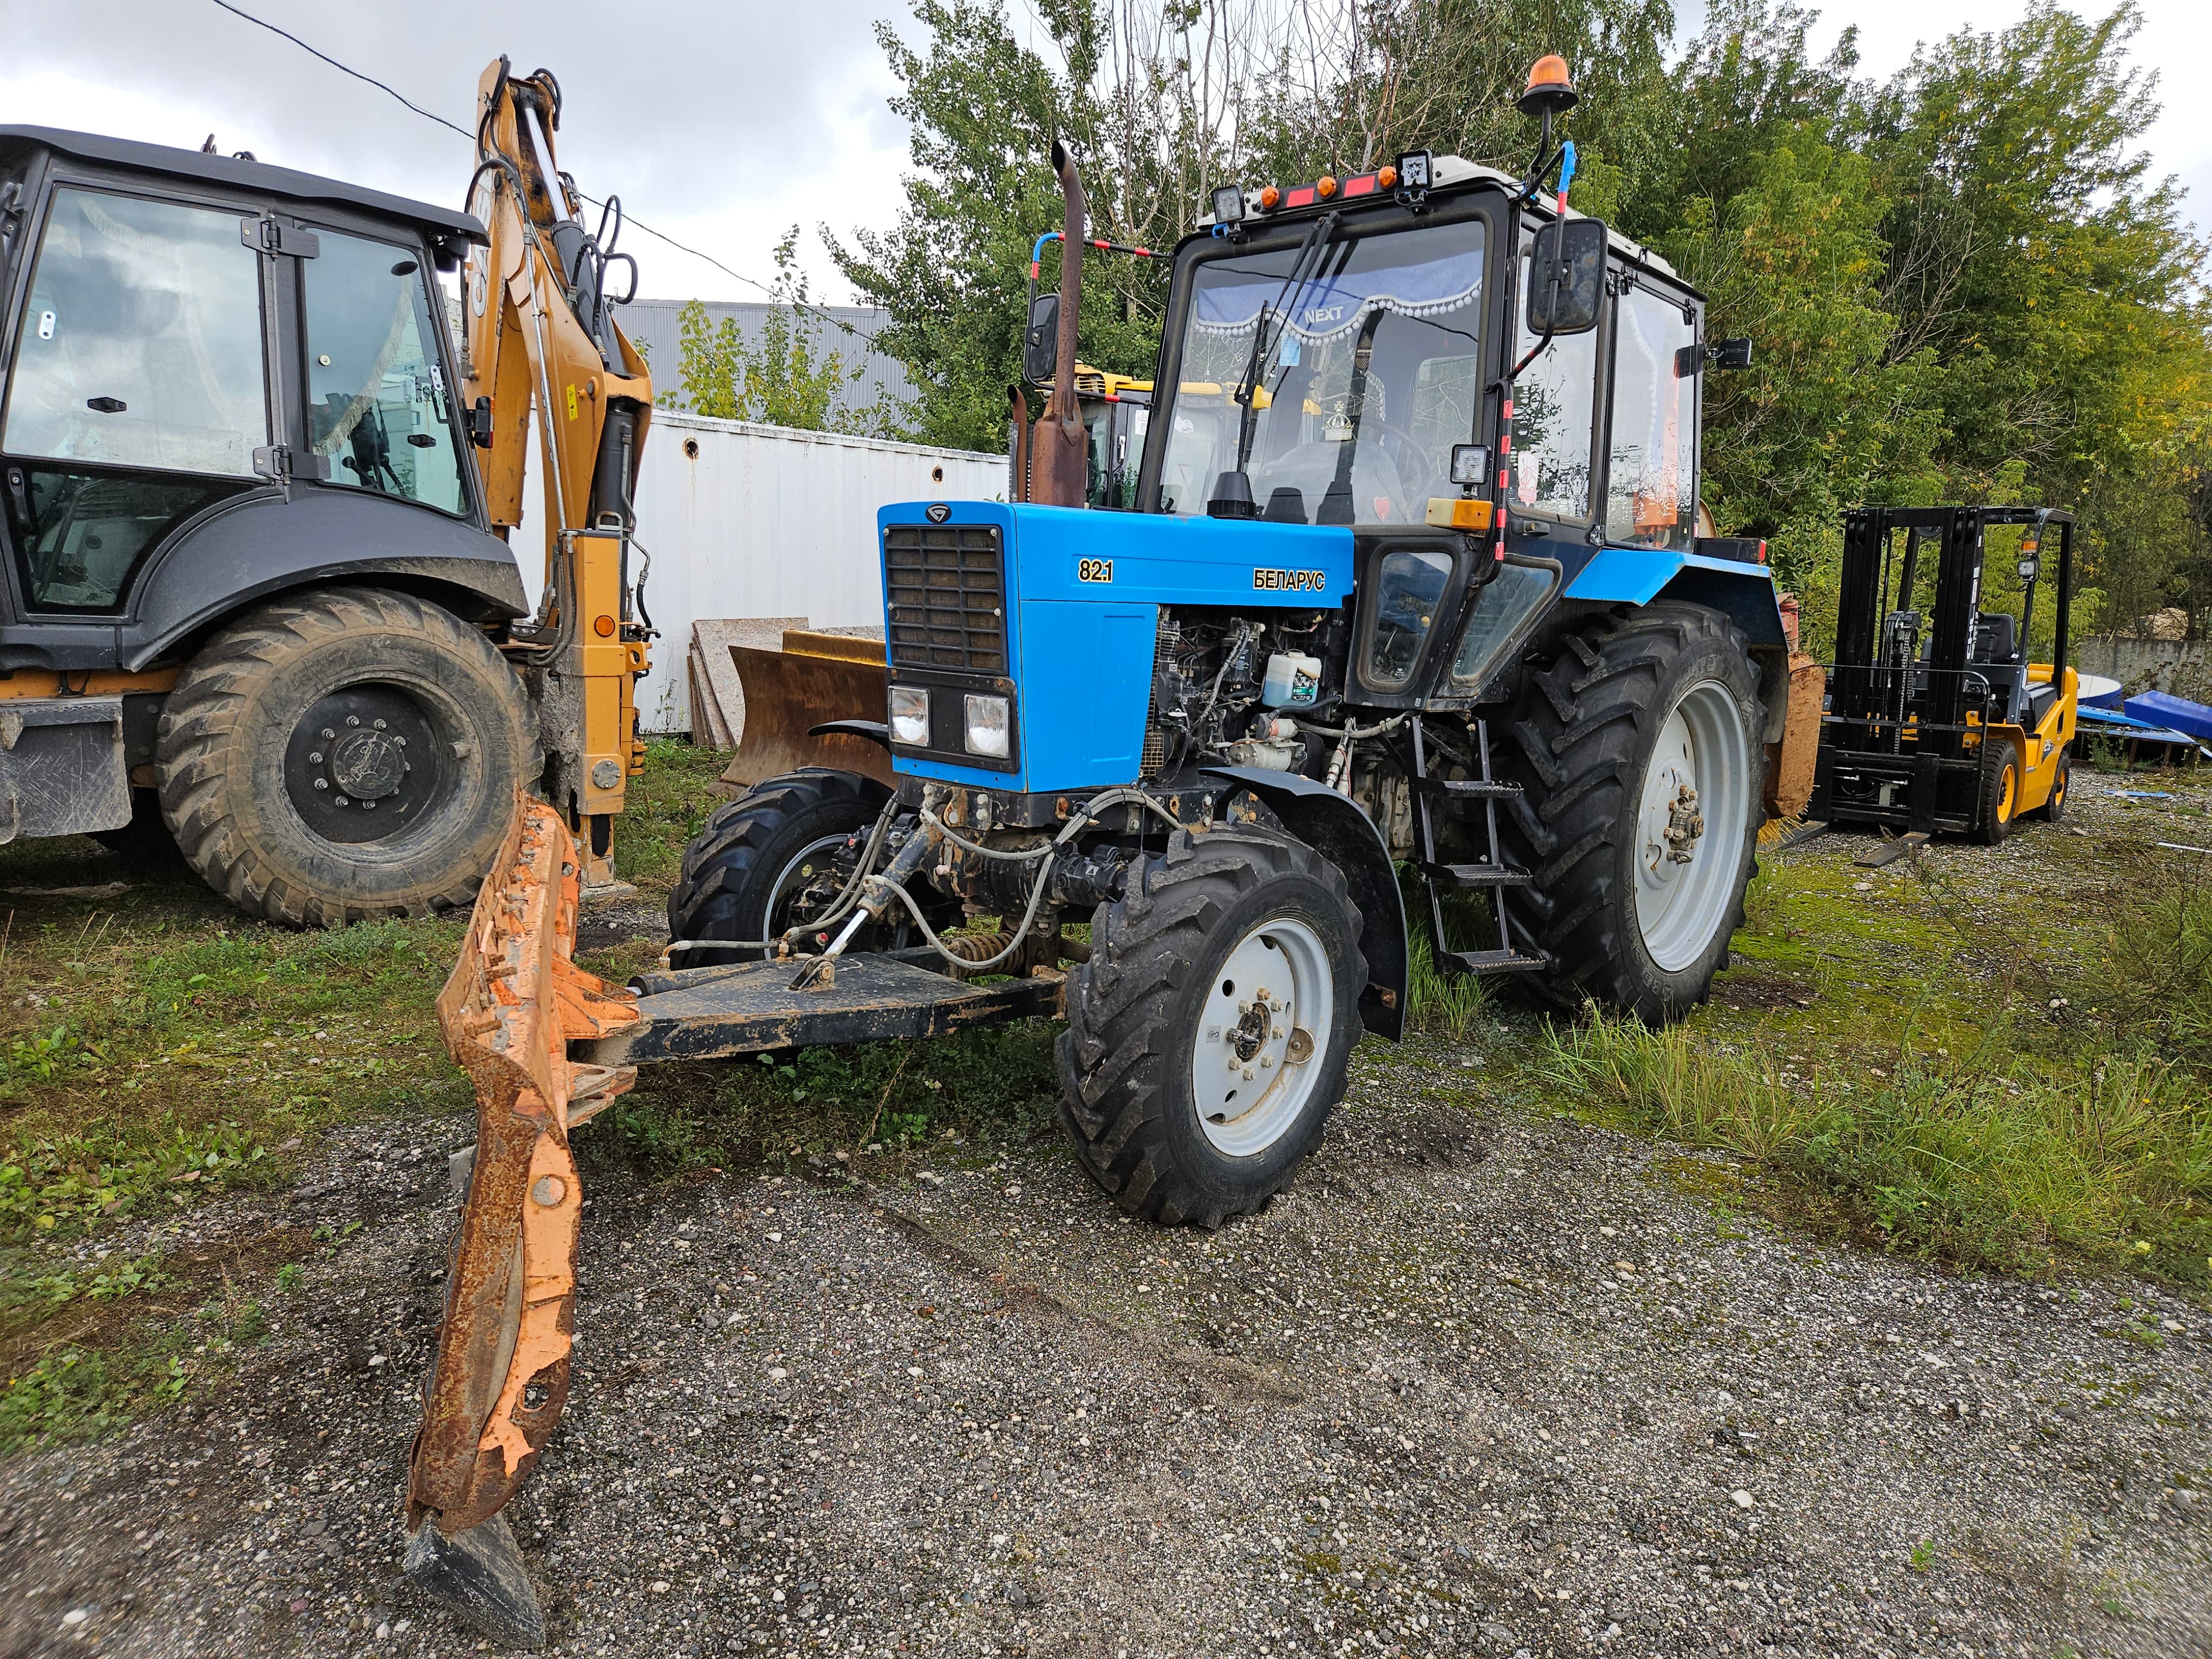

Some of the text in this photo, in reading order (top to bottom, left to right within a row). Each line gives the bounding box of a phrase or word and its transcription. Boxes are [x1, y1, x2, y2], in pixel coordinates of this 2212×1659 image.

[1304, 306, 1343, 324] NEXT
[1078, 558, 1113, 584] 82.1
[1253, 568, 1325, 592] БЕЛАРУС
